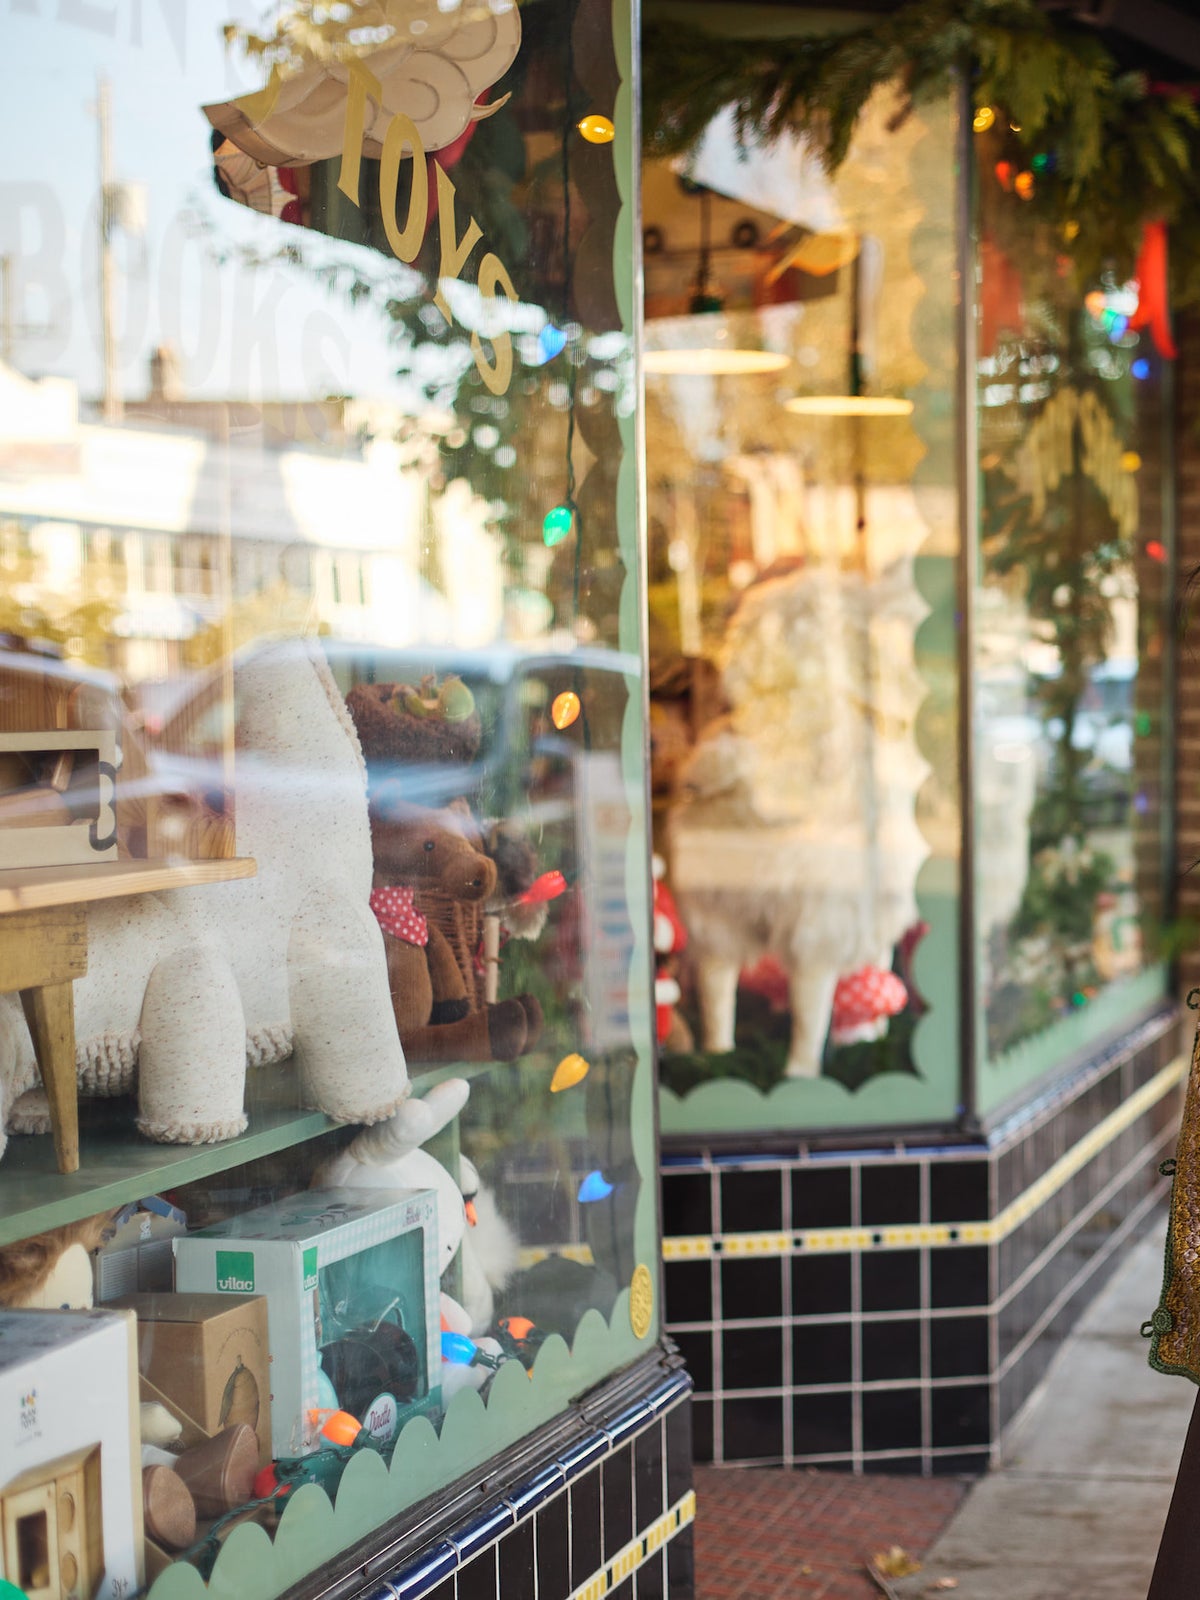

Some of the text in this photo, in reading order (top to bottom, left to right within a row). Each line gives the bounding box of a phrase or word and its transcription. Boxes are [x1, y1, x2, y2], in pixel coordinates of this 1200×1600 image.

[337, 57, 520, 396] TOYS
[0, 180, 351, 441] BOOKS
[218, 1276, 253, 1291] vilac
[369, 1402, 392, 1432] Dinette
